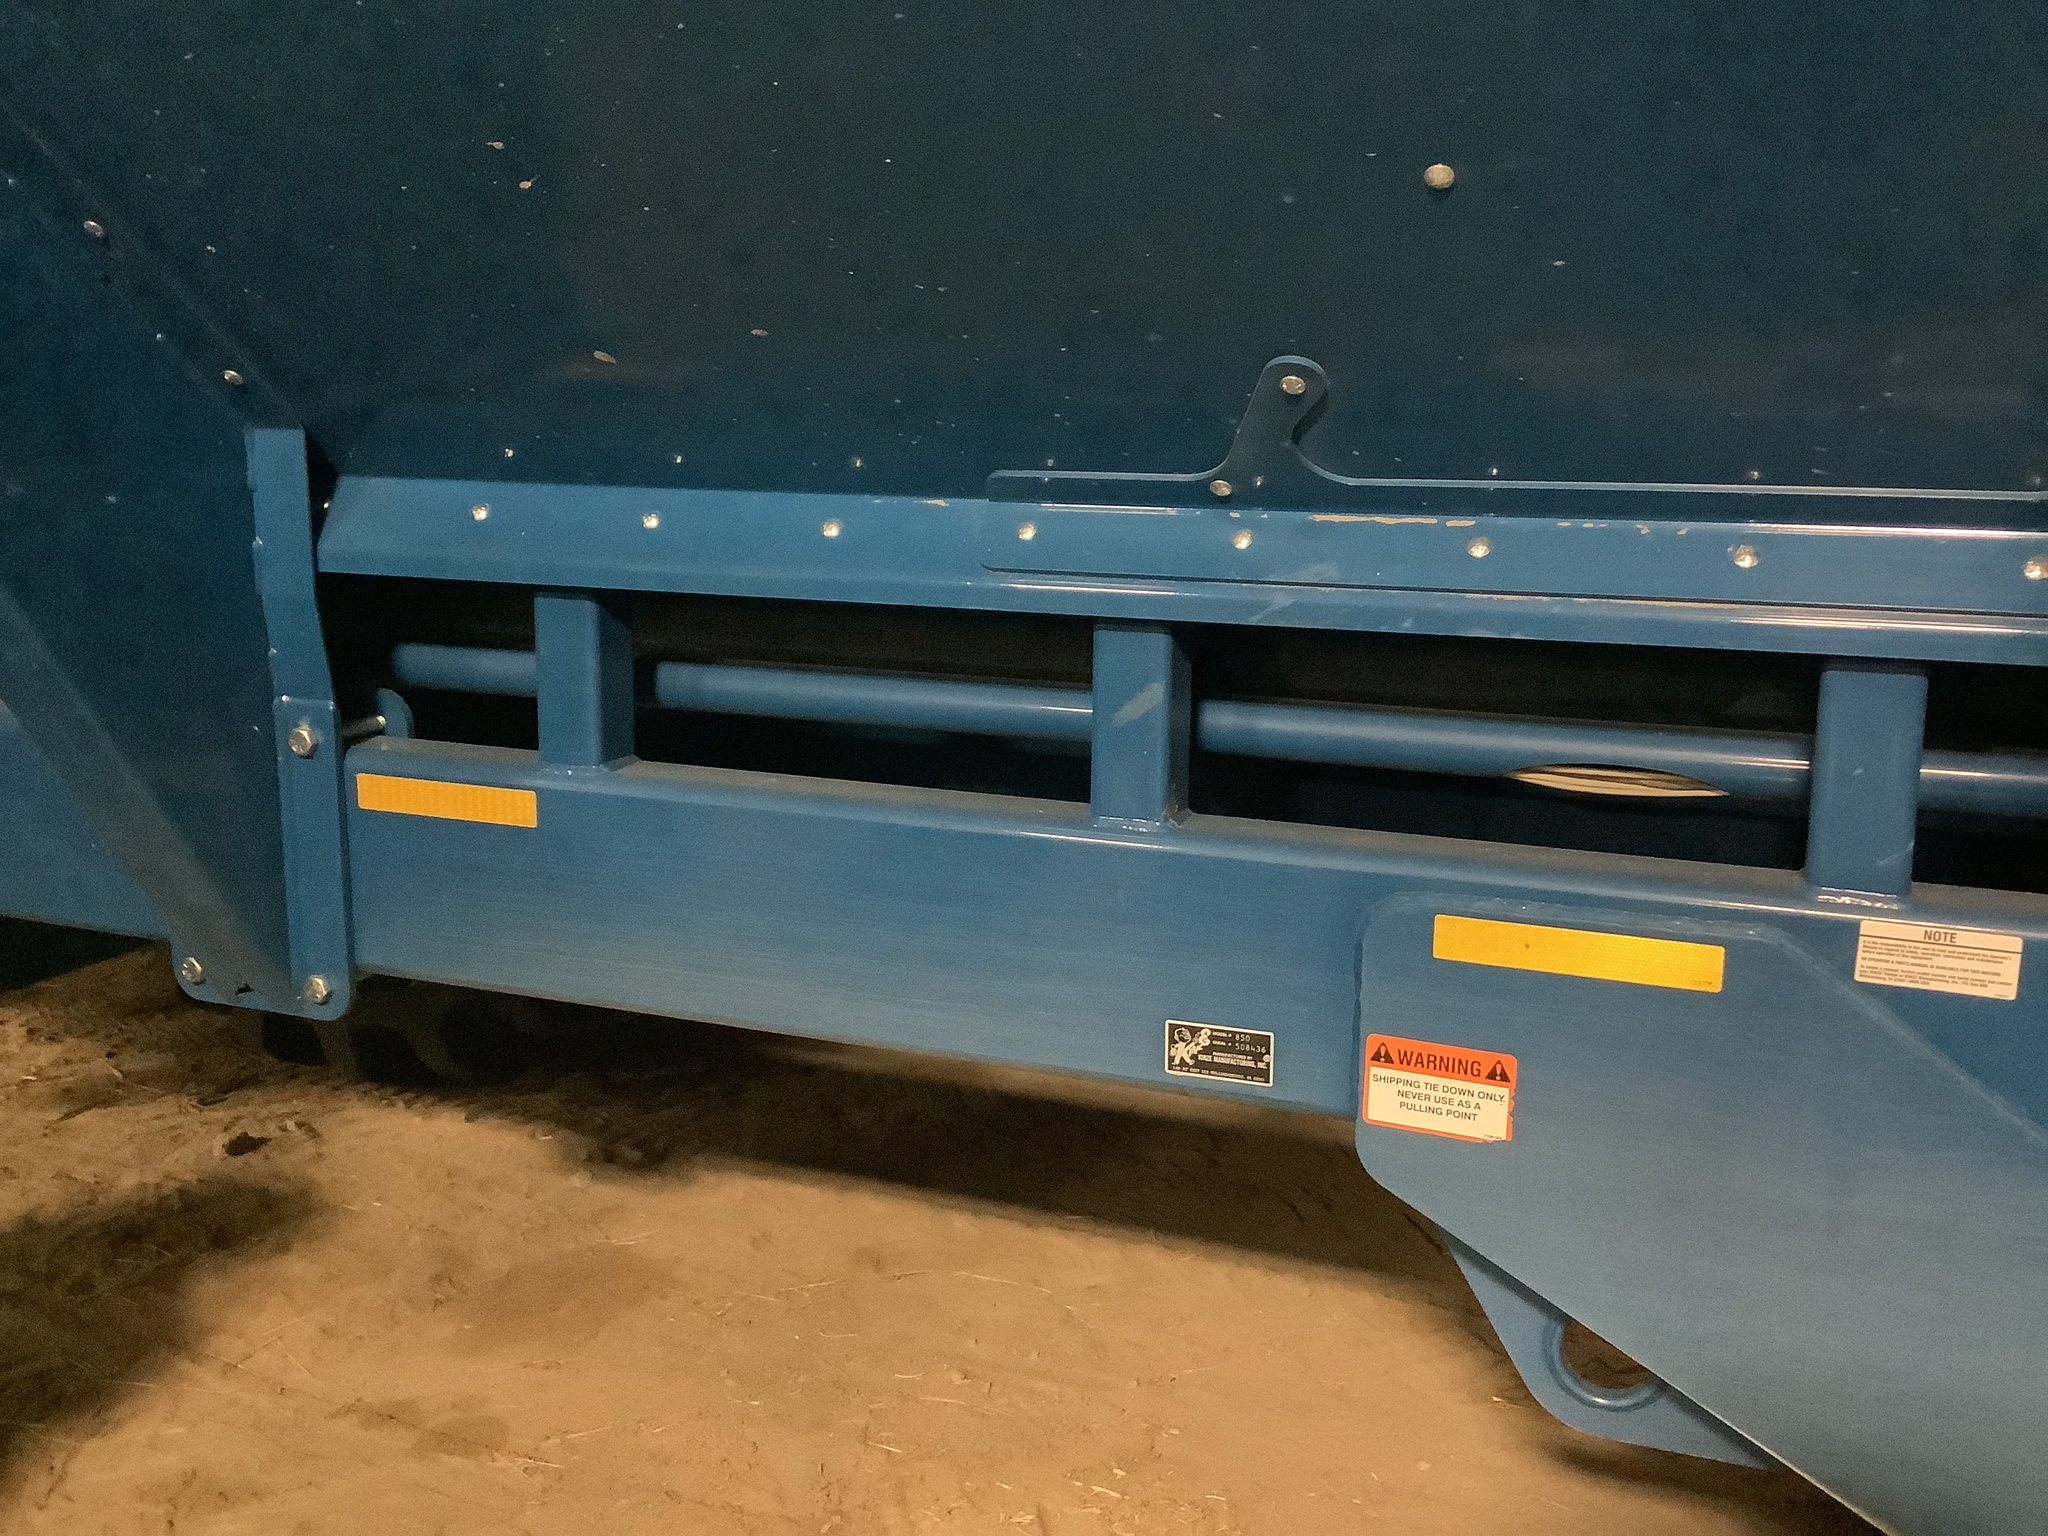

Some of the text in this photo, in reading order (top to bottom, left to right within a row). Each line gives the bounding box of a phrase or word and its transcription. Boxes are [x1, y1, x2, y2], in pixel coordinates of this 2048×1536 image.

[1923, 929, 1958, 944] NOTE
[1234, 1042, 1266, 1053] 508436
[1235, 1033, 1250, 1042] 850
[1397, 1048, 1482, 1078] WARNING
[1372, 1074, 1420, 1089] SHIPPING
[1423, 1082, 1439, 1092] TIE
[1442, 1084, 1475, 1098] DOWN
[1397, 1089, 1481, 1111] NEVER USE AS A
[1399, 1101, 1478, 1122] PULLING POINT
